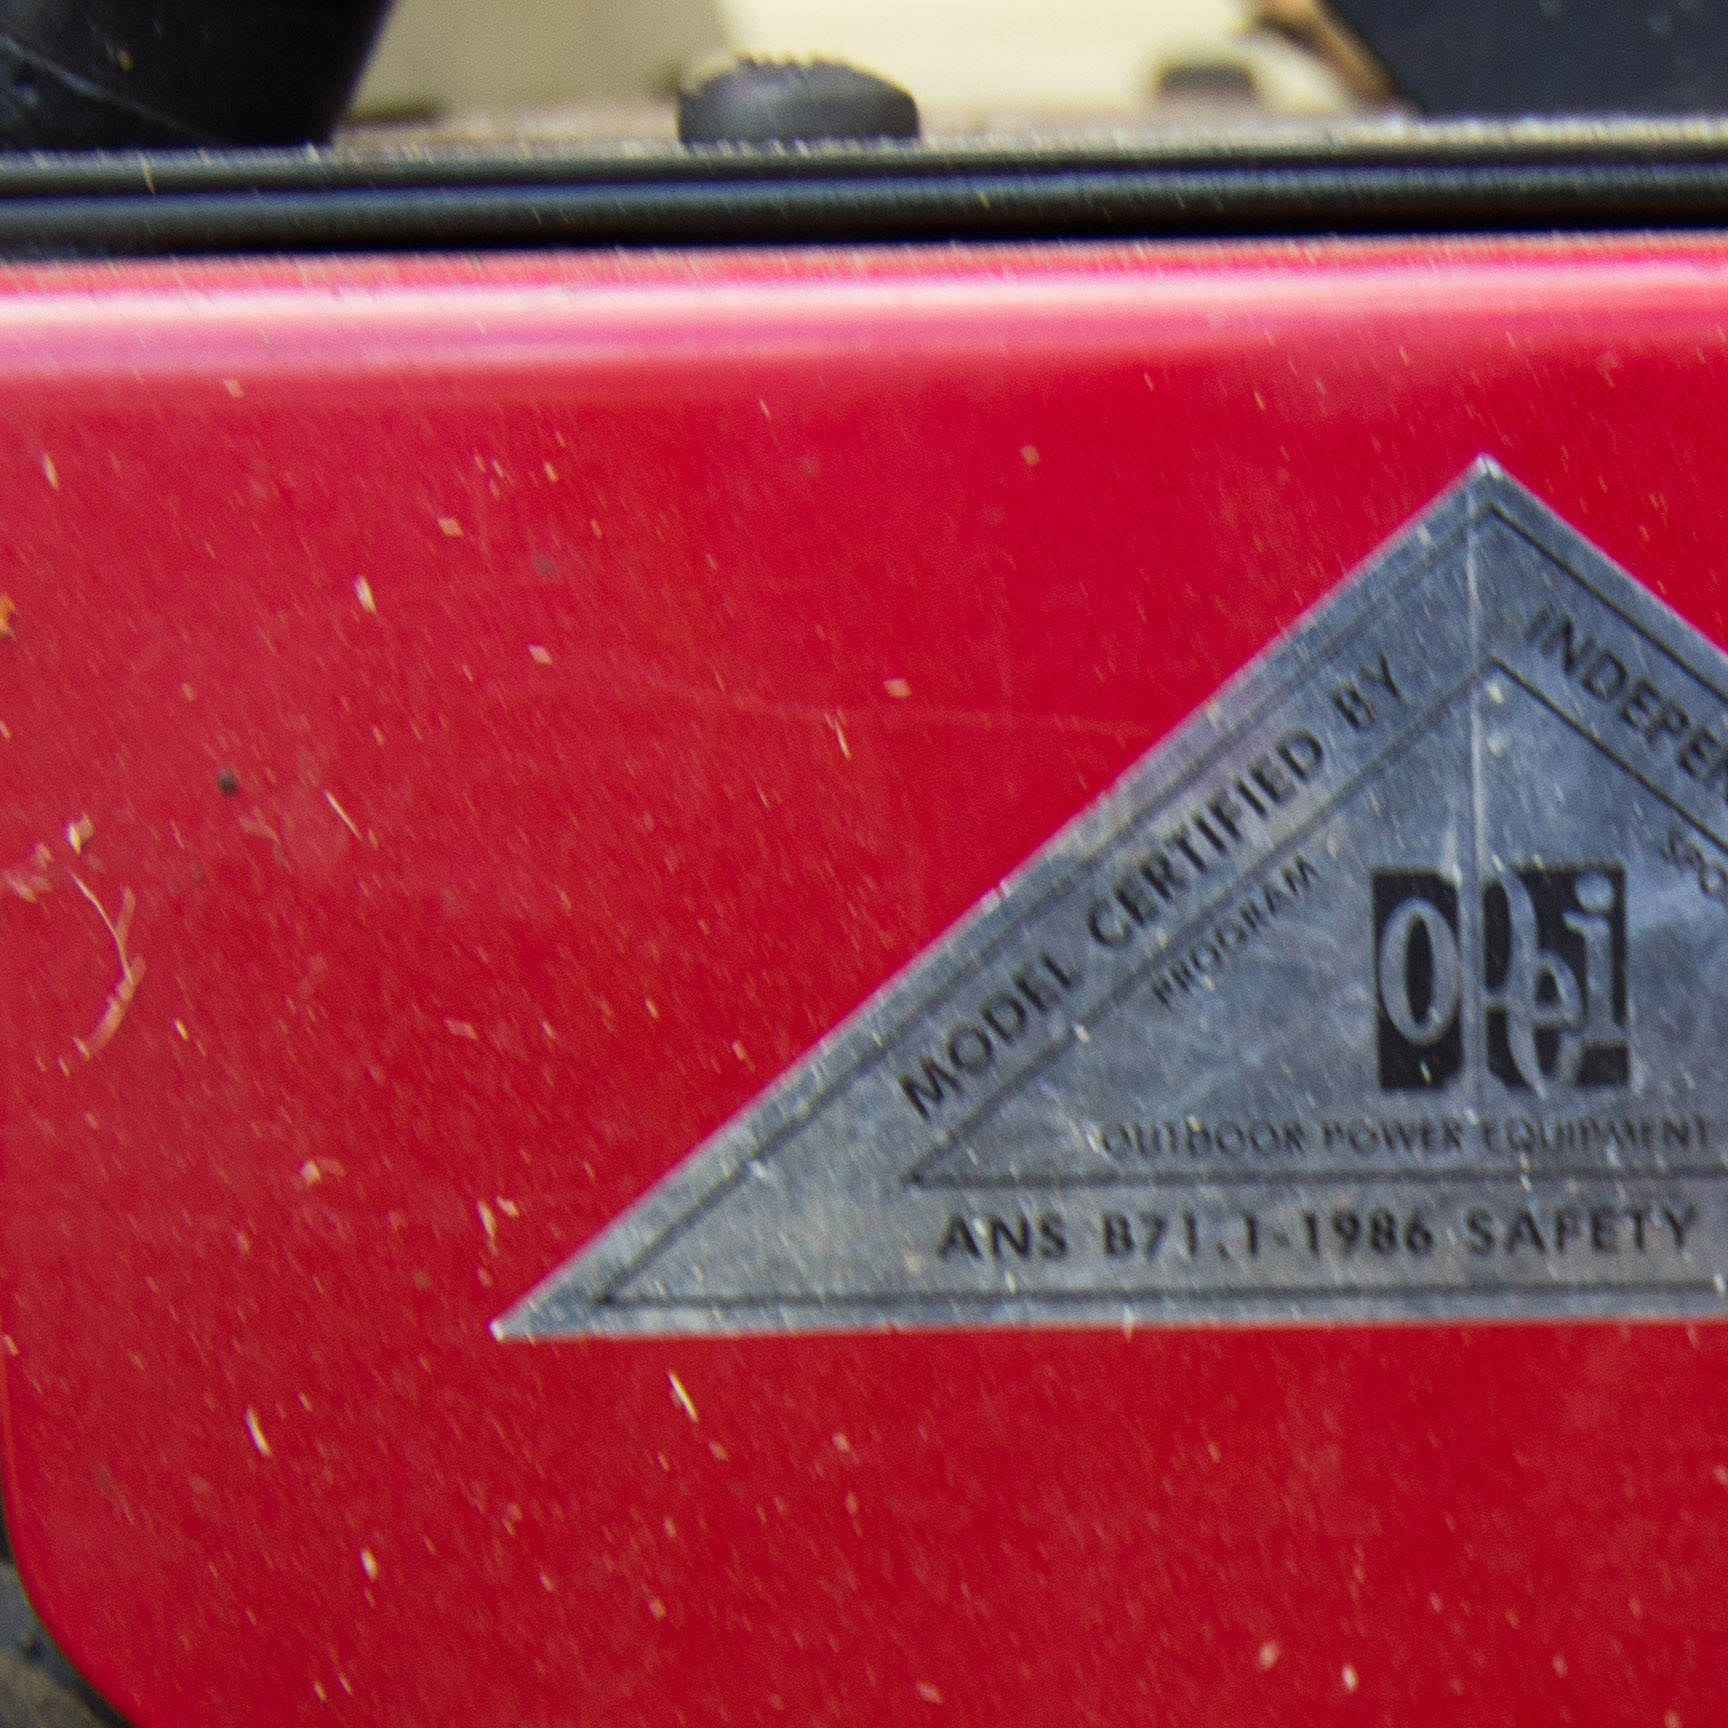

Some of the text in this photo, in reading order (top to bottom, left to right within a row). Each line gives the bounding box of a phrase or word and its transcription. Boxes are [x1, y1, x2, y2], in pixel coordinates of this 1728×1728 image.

[900, 649, 1404, 1120] MODEL CERTIFIED BY
[1150, 855, 1319, 1010] PROGRAM
[1100, 1120, 1304, 1158] OUTDOOR
[1321, 1118, 1463, 1154] POWER
[1480, 1116, 1709, 1154] EQUIPMENT
[936, 1211, 1068, 1260] ANS
[1466, 1206, 1694, 1255] SAFETY
